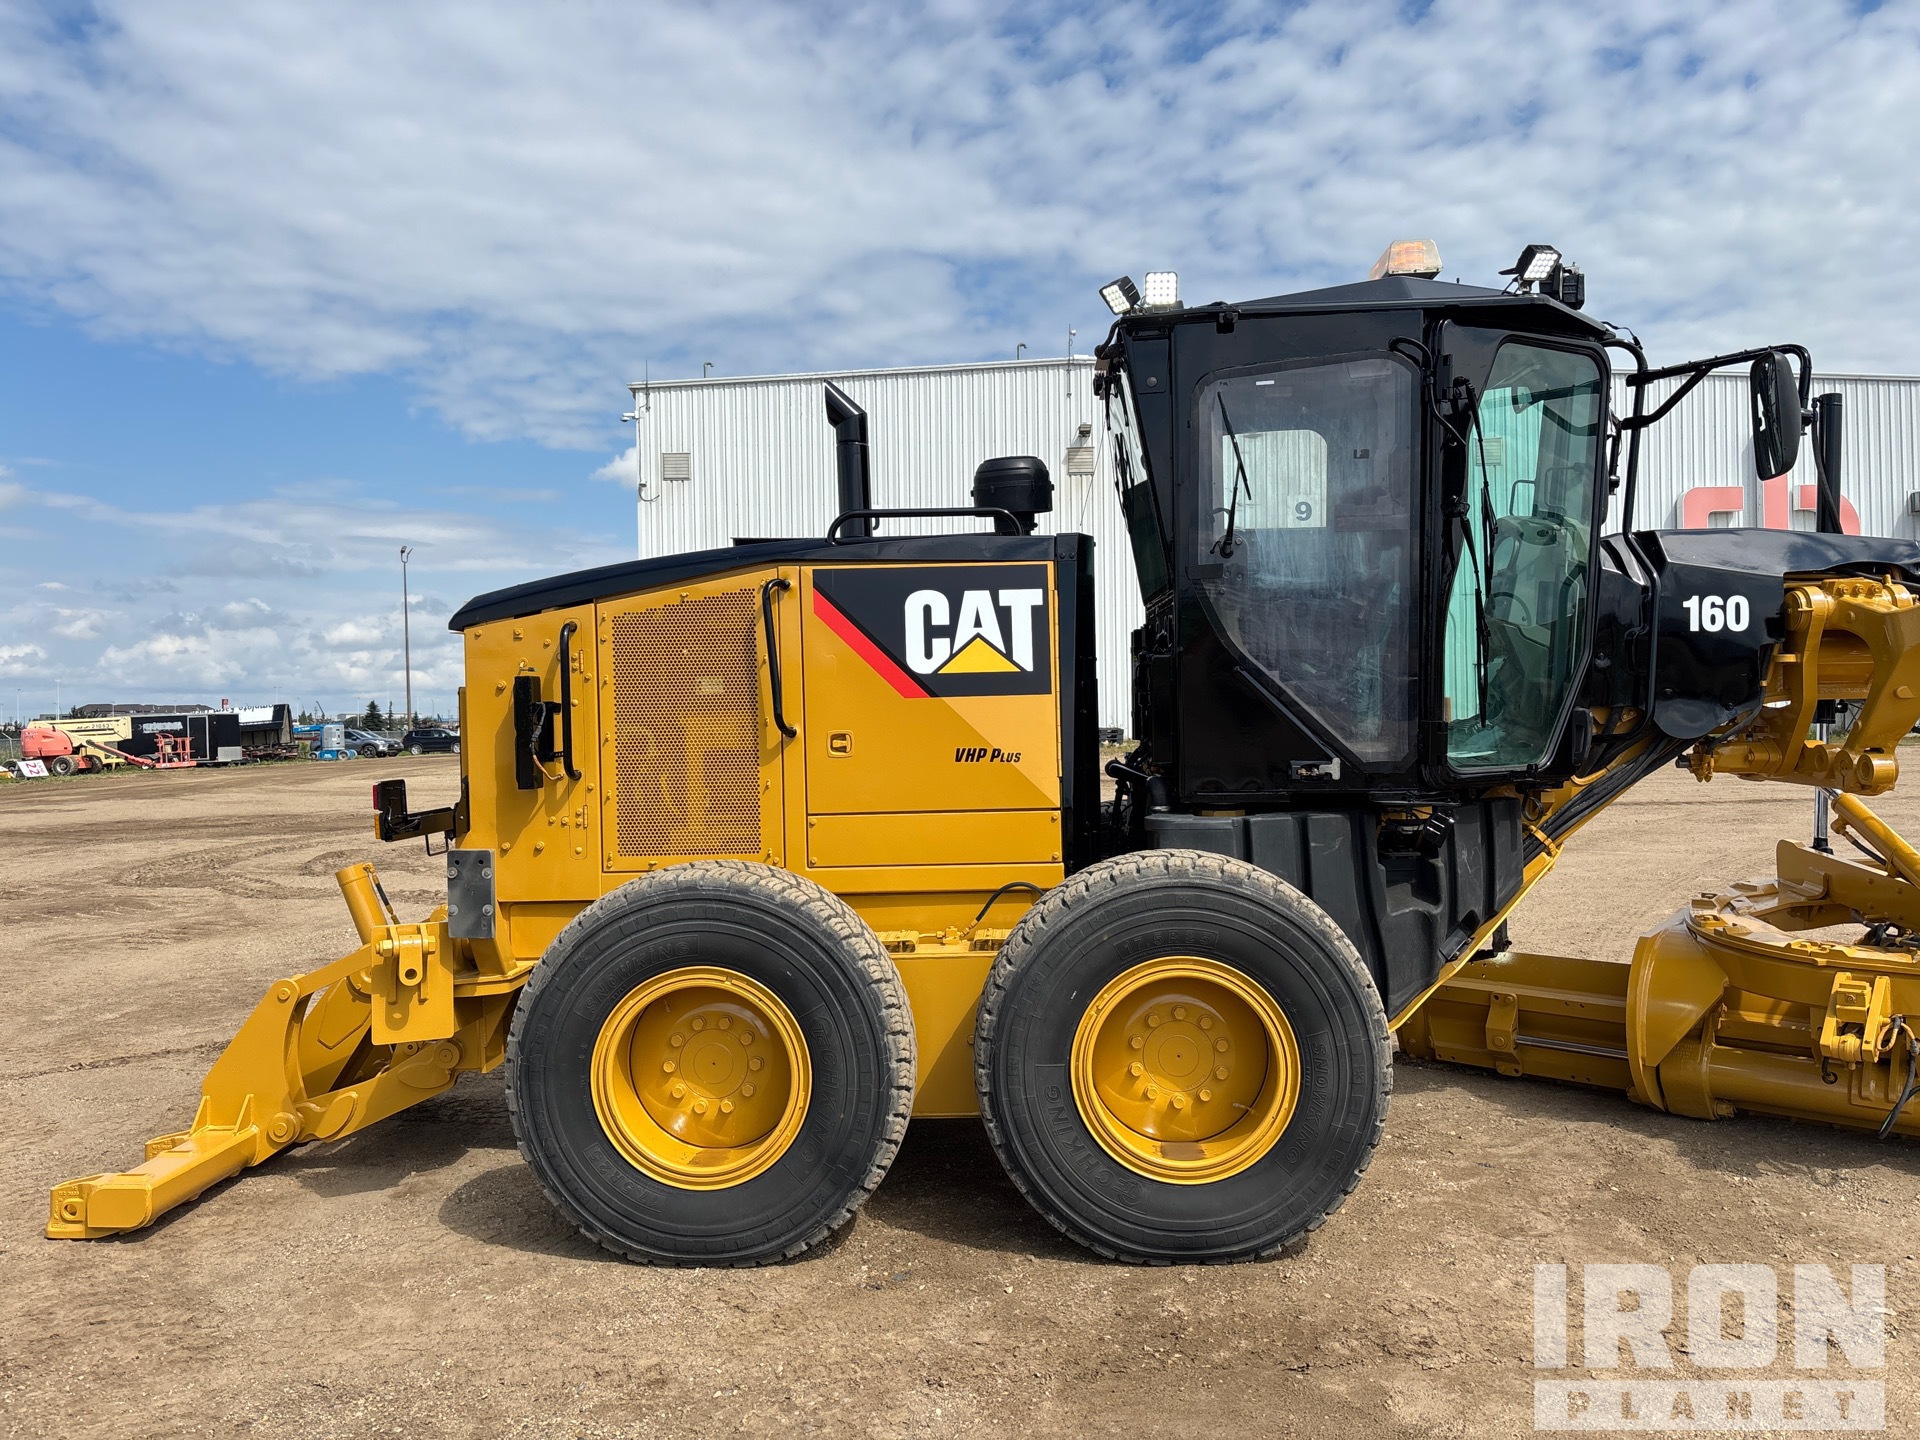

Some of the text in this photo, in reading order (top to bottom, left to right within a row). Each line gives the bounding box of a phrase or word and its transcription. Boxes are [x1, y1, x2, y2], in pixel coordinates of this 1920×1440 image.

[1294, 501, 1313, 522] 9
[1682, 594, 1750, 632] 160
[904, 588, 1044, 675] CAT
[954, 747, 988, 763] VHP
[25, 762, 41, 775] 22
